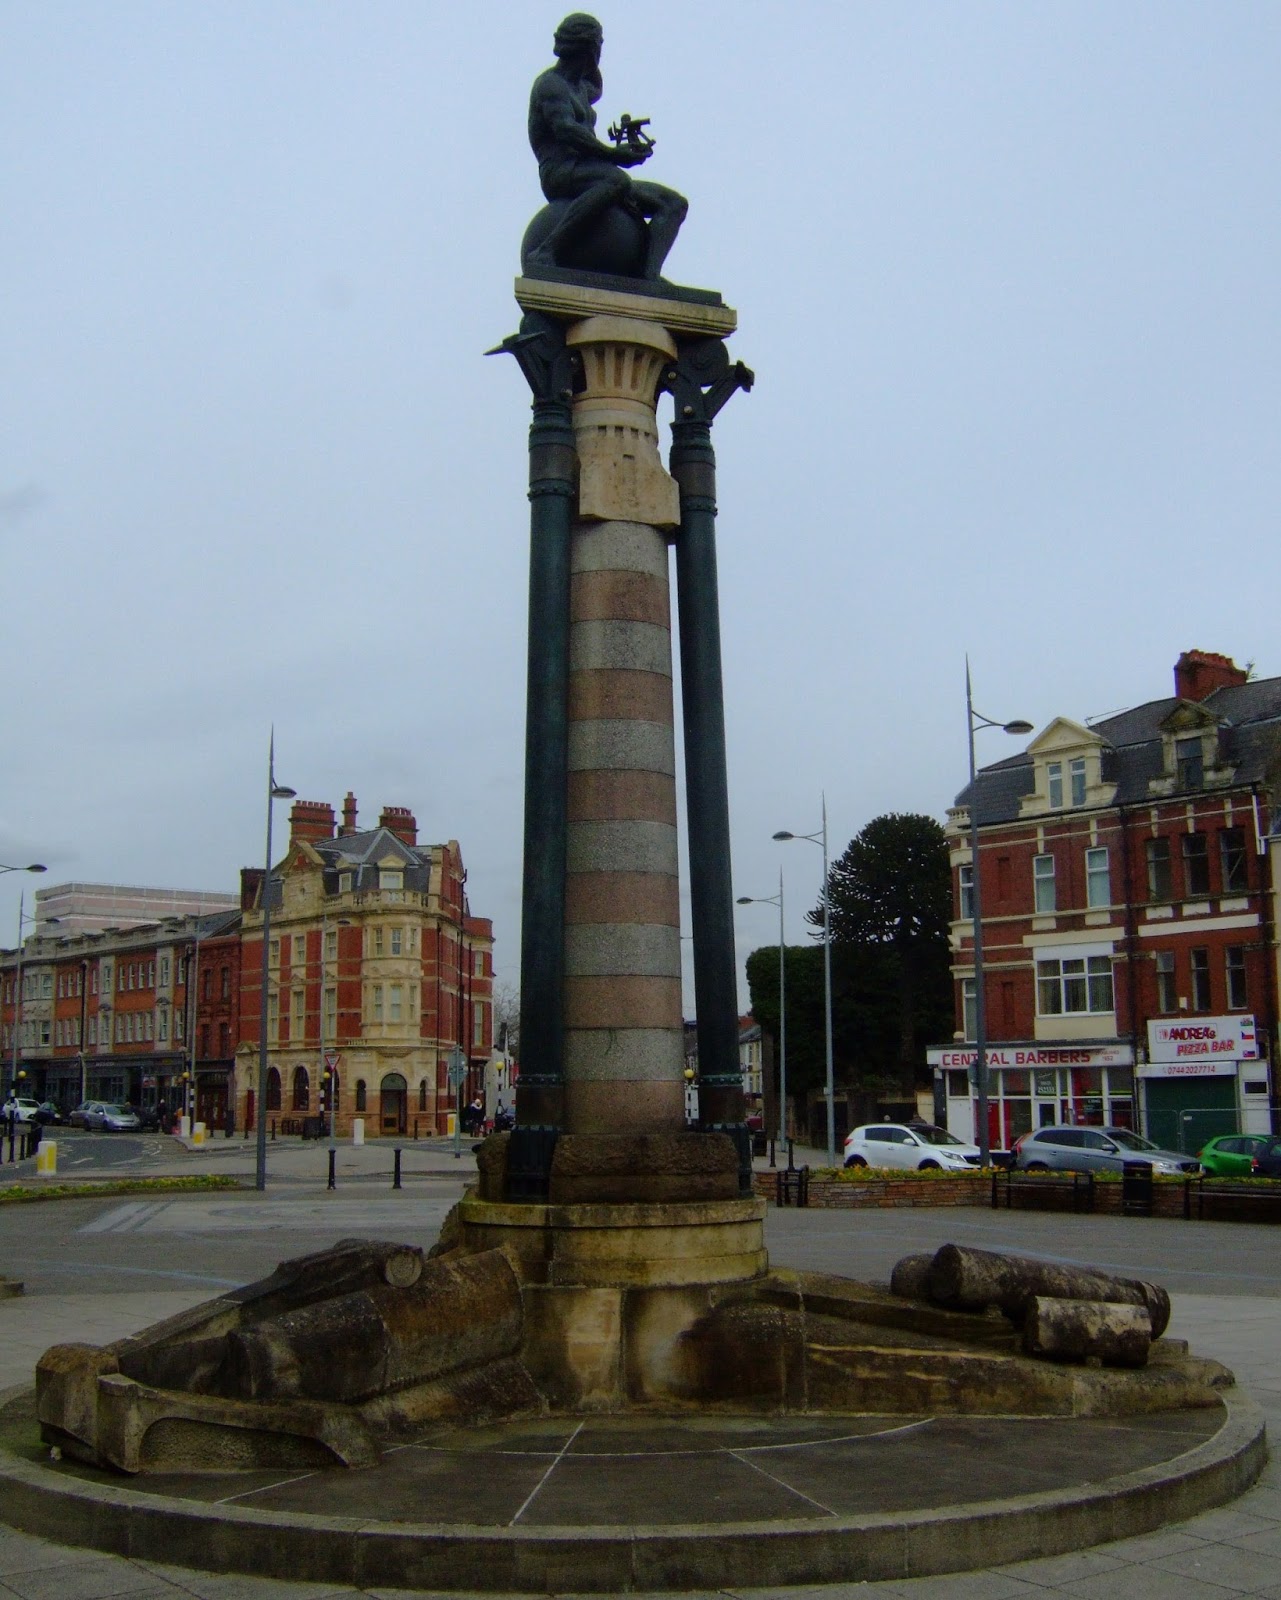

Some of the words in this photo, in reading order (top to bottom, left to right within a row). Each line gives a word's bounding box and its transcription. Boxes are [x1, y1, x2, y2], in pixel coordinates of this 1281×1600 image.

[1176, 1042, 1209, 1056] PIZZA
[1211, 1039, 1235, 1053] BAR
[1015, 1051, 1091, 1065] BARBERS
